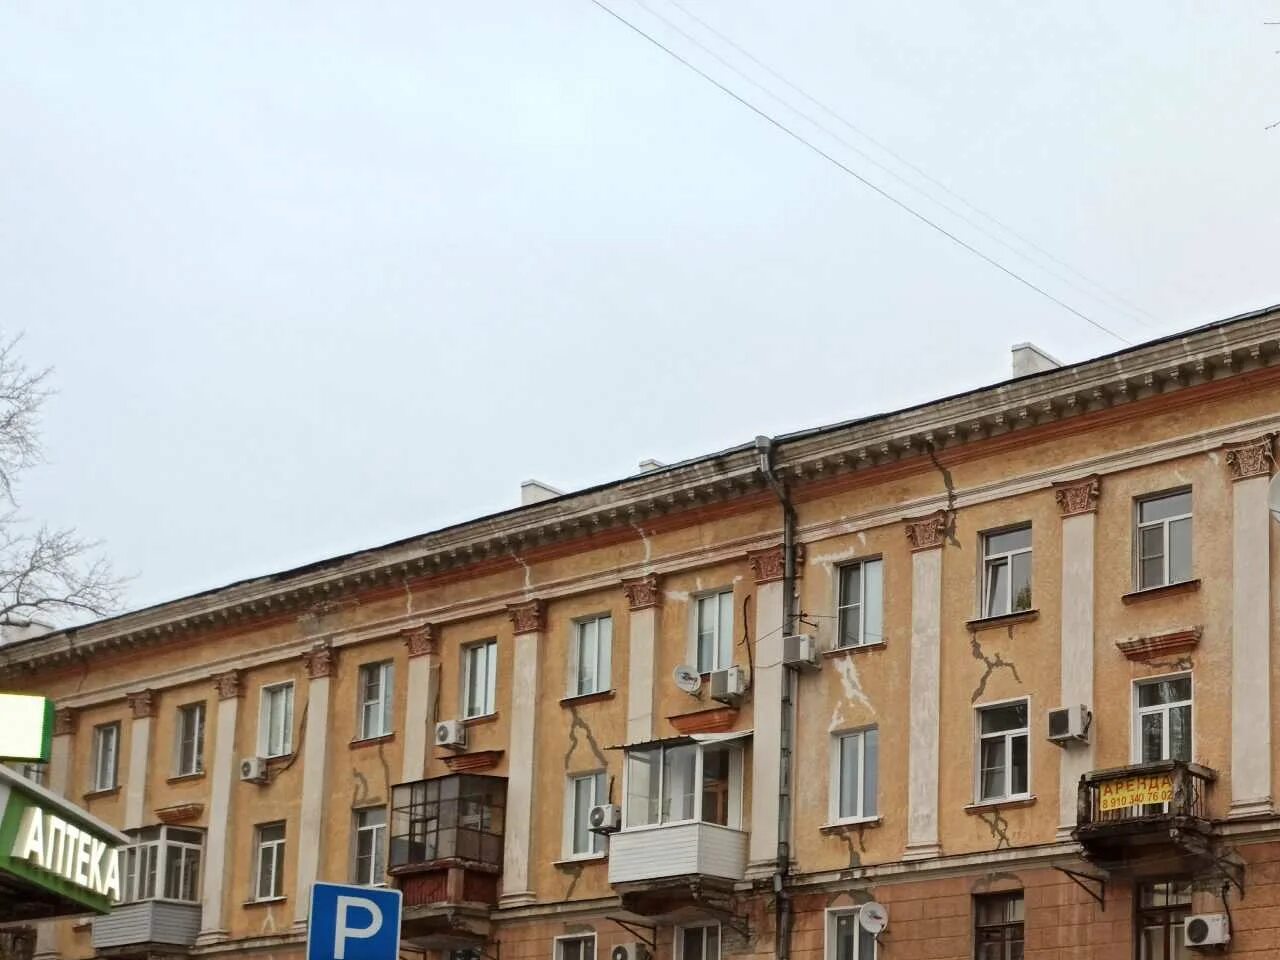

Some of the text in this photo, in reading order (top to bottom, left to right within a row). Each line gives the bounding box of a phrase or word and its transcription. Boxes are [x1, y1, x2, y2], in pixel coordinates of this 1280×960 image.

[1103, 775, 1173, 797] АРЕНДА
[22, 806, 120, 901] АПТЕКА
[333, 894, 383, 960] P
